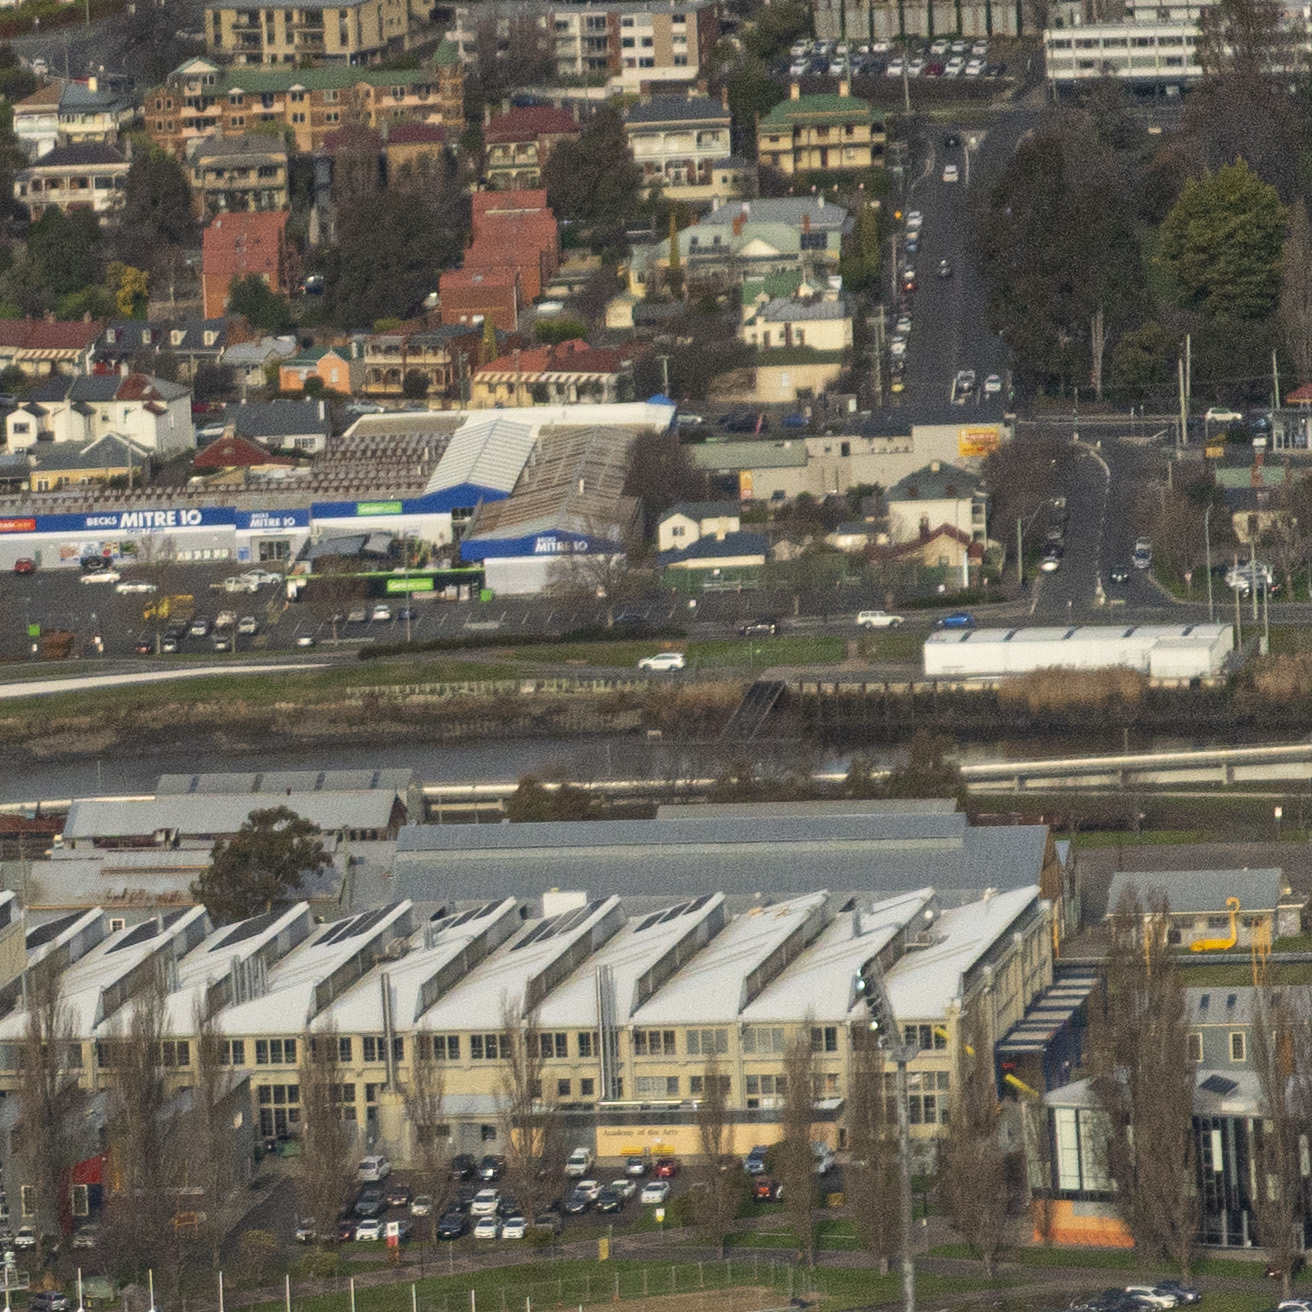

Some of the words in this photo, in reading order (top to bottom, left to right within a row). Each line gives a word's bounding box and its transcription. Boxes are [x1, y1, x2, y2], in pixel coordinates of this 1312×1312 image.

[87, 517, 117, 527] BECKS
[120, 511, 176, 528] MITRE
[180, 509, 202, 525] 10
[250, 518, 280, 527] MITRE
[283, 517, 295, 526] 10
[603, 1129, 634, 1137] Academy
